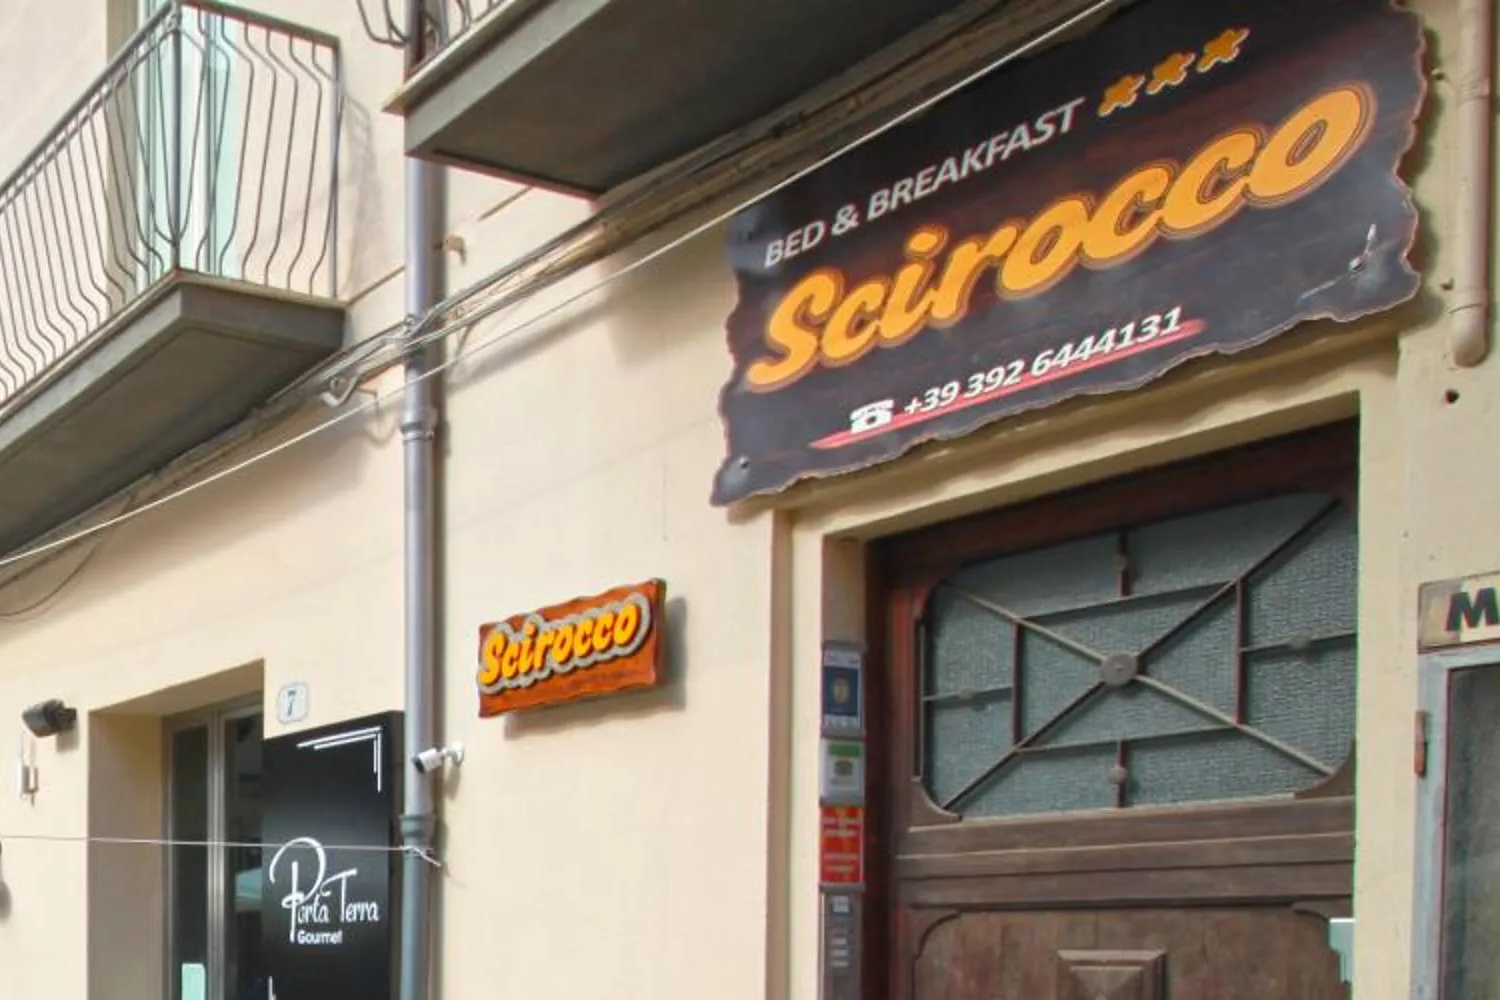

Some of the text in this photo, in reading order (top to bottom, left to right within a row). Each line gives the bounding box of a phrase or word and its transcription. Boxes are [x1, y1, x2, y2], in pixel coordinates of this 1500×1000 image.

[764, 96, 1086, 269] BED & BREAKFAST
[746, 88, 1372, 388] Scirocco
[903, 306, 1183, 417] +39 392 6444131
[478, 601, 640, 686] Scirocco
[287, 690, 297, 717] 7
[269, 836, 380, 943] Porta Terra
